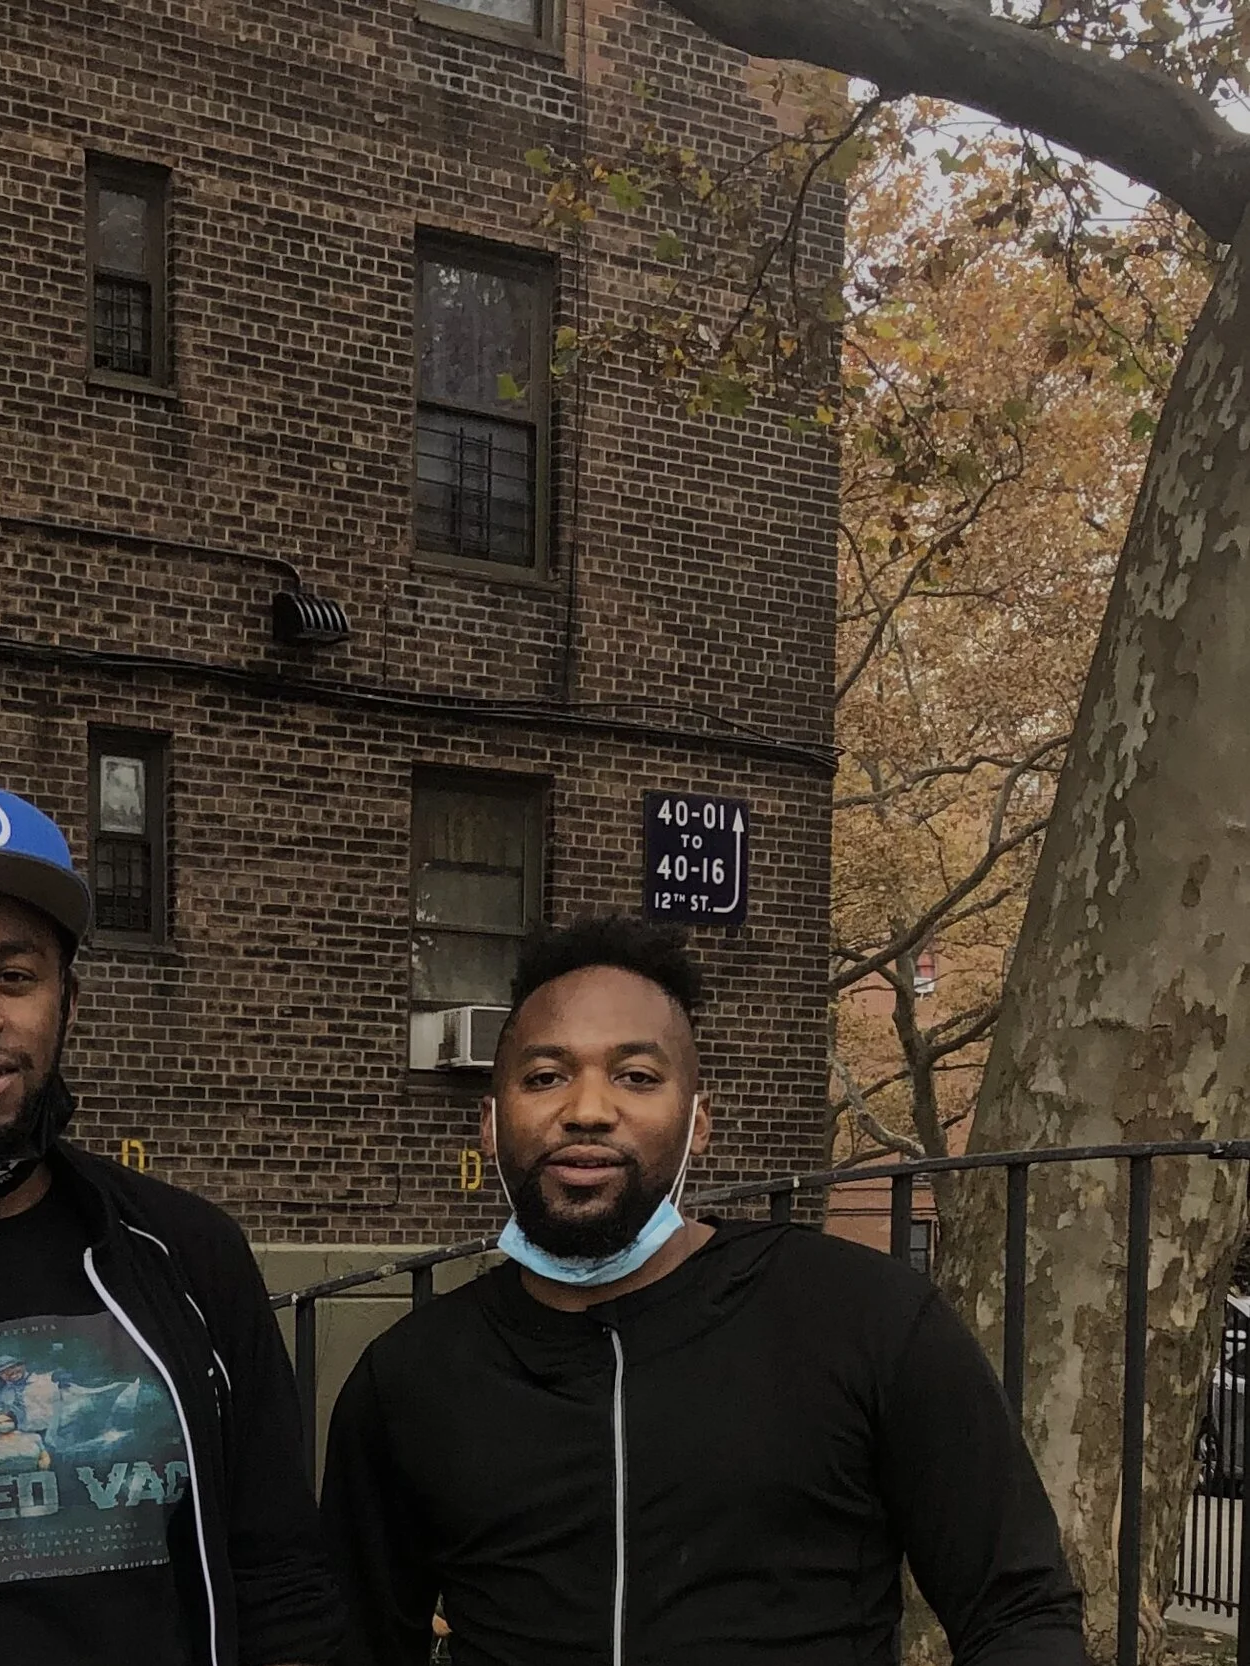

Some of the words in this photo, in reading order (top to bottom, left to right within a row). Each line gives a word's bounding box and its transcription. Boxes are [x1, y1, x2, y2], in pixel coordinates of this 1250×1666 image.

[657, 799, 725, 830] 40-01
[680, 834, 703, 849] TO
[656, 854, 725, 885] 40-16
[460, 1150, 482, 1190] D
